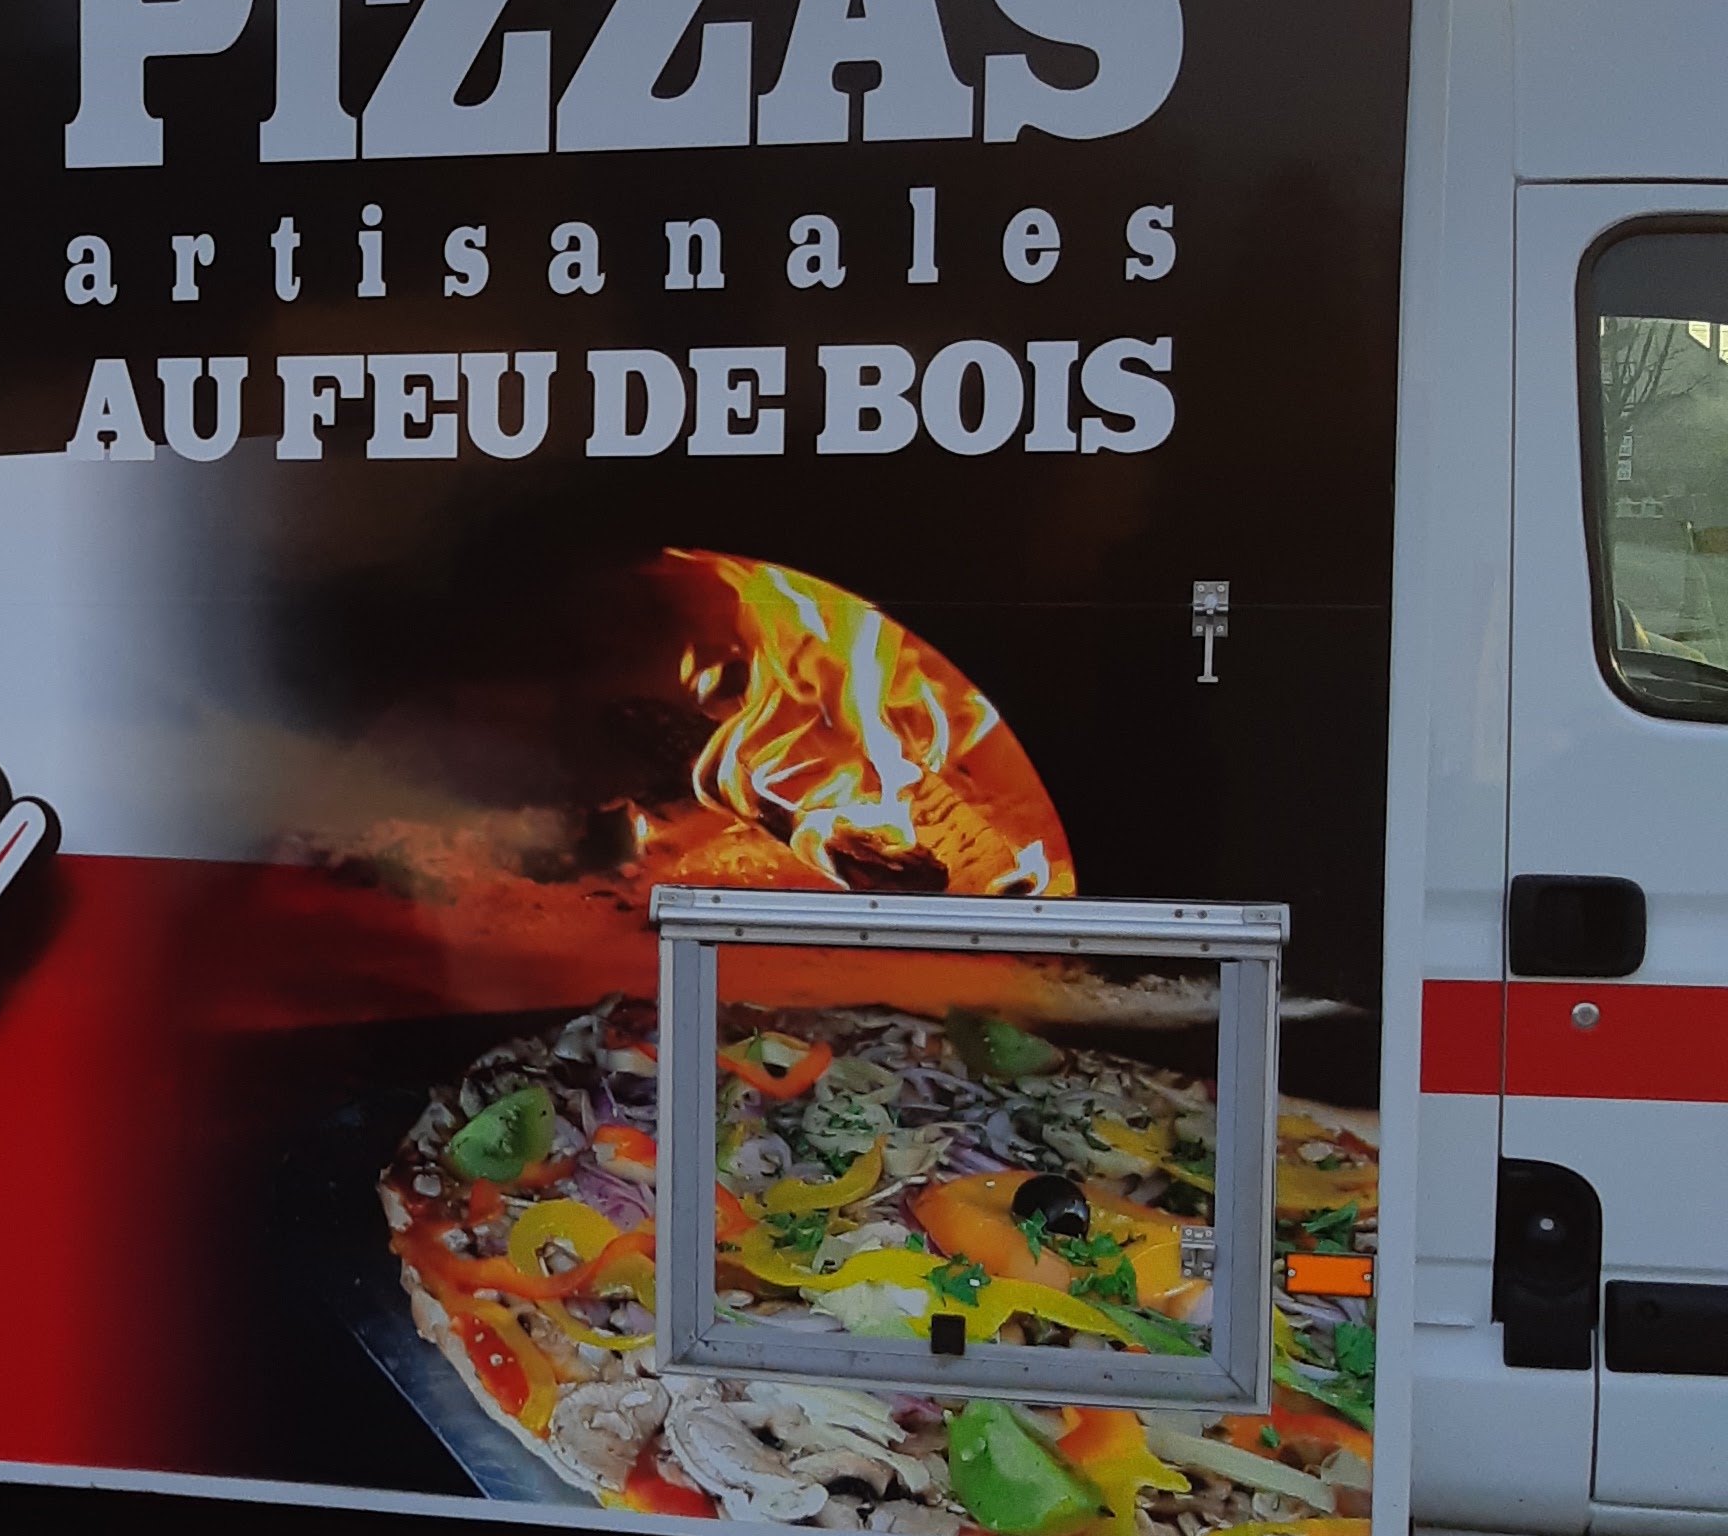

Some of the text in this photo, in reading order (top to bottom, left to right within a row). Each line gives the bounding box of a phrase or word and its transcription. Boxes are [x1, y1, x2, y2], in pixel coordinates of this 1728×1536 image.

[64, 187, 1178, 306] artisanales
[65, 336, 1177, 463] AU FEU DE BOIS
